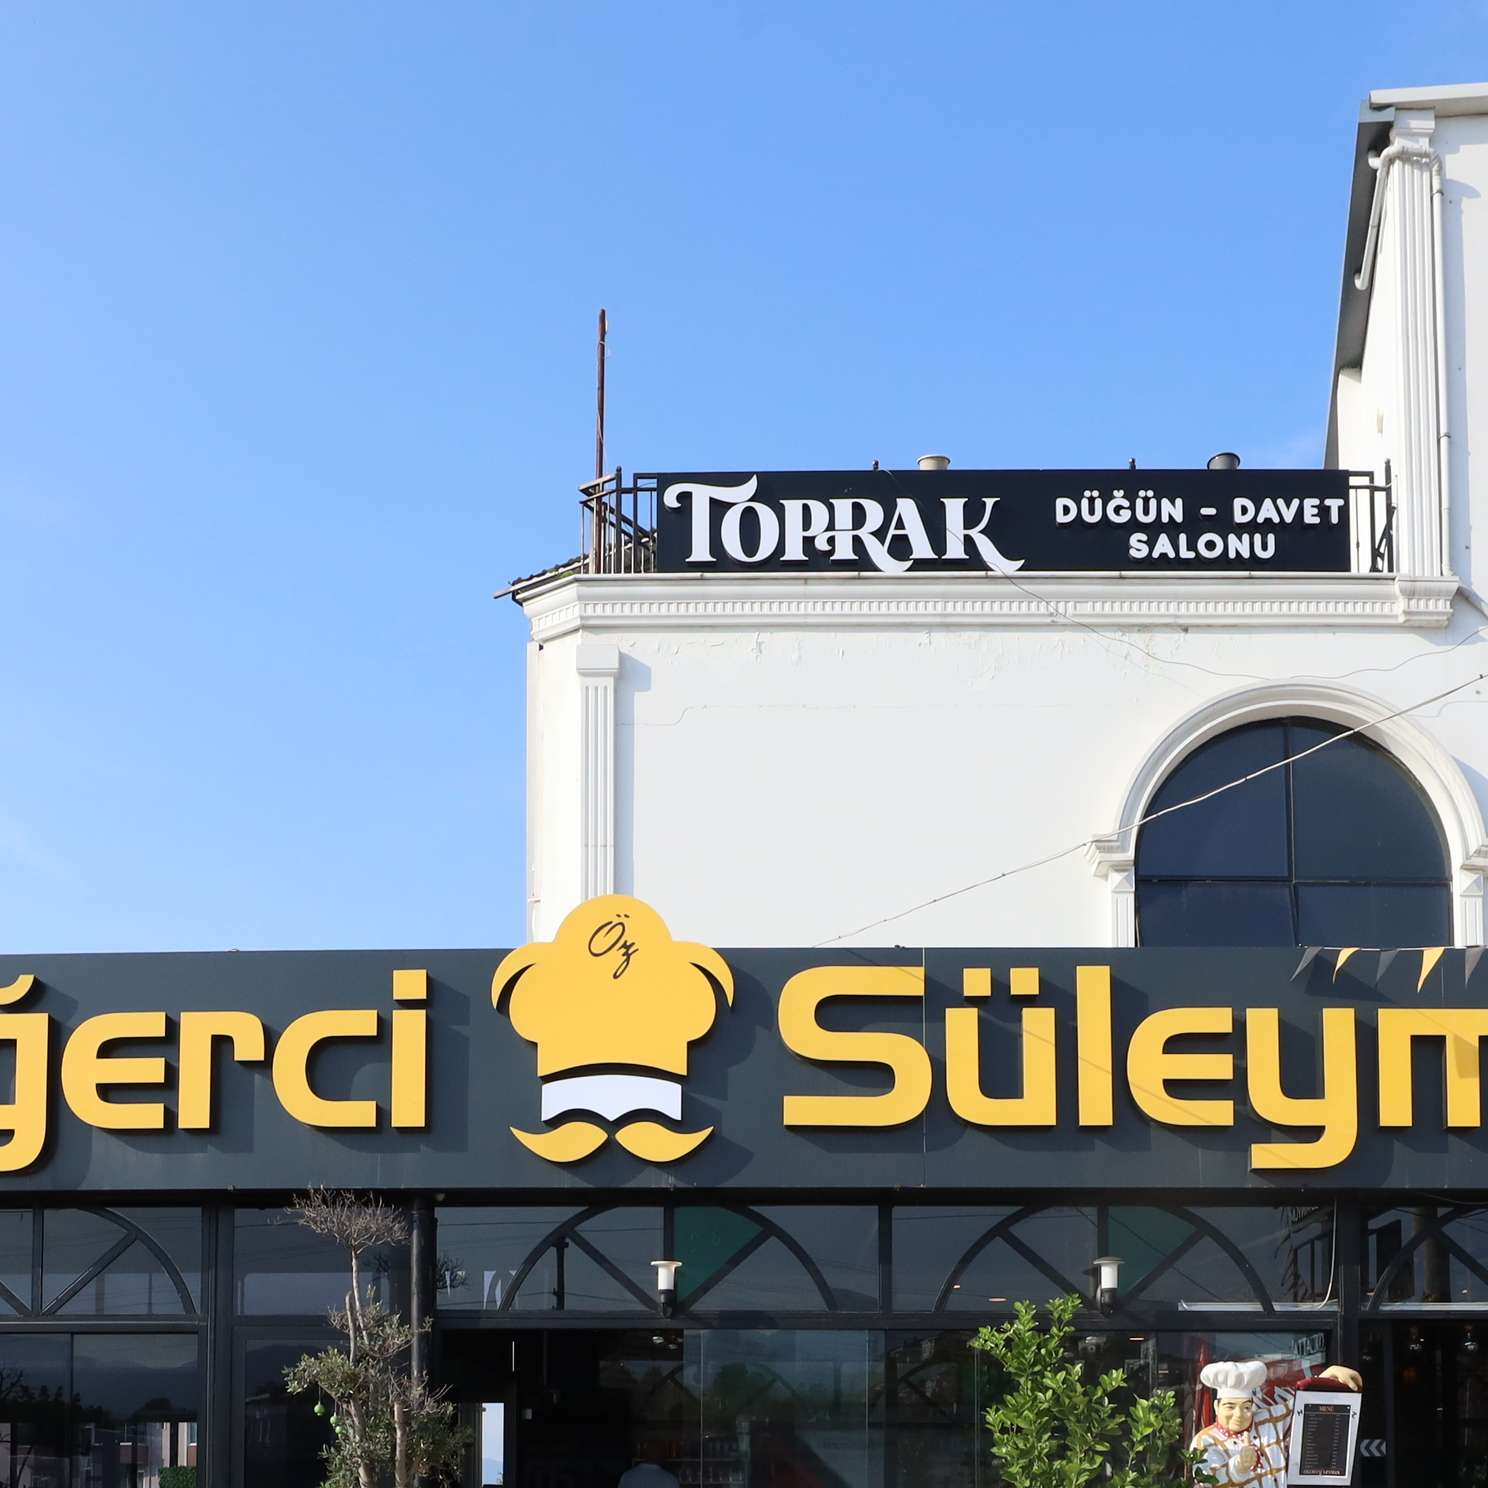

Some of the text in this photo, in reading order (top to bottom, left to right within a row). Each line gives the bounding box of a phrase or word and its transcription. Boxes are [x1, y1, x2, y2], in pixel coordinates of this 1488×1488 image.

[664, 475, 1025, 573] TOPRAK
[1056, 489, 1184, 524] DÜĞÜN
[1234, 498, 1345, 525] DAVET
[1129, 532, 1276, 559] SALONU
[587, 912, 639, 980] Öz
